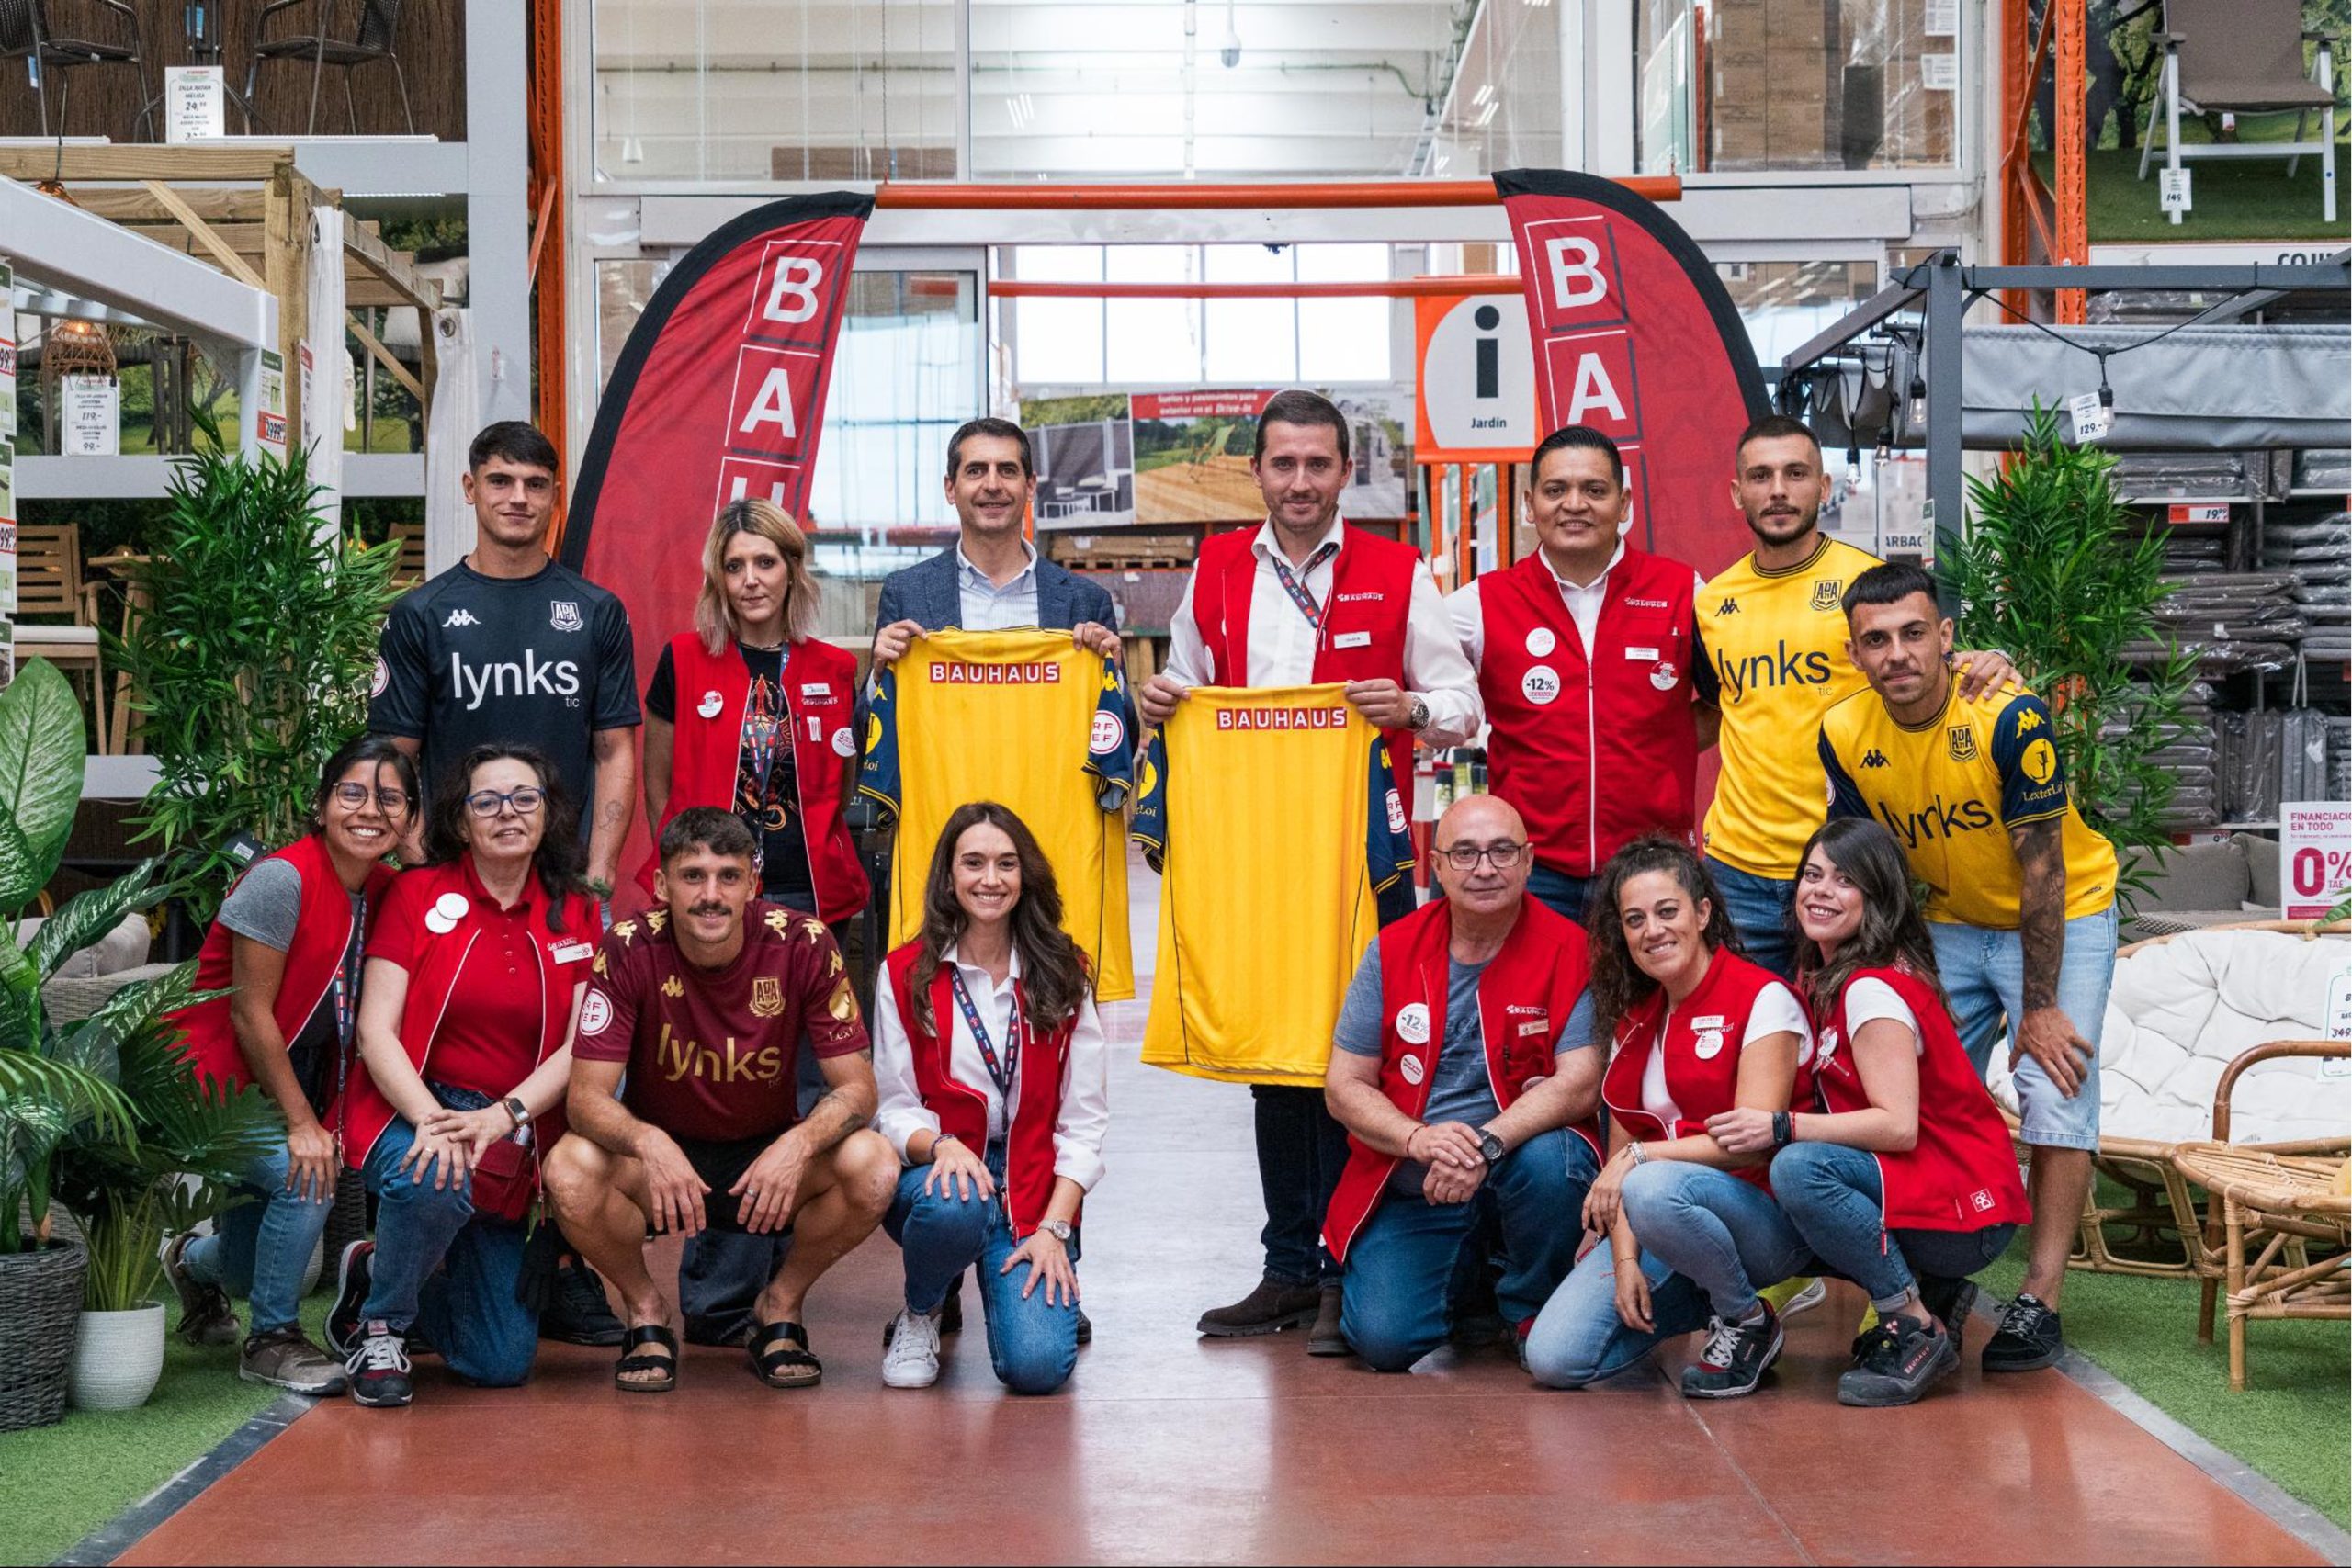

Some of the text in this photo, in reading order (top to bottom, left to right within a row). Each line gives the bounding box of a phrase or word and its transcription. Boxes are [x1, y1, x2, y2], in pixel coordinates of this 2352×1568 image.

[451, 649, 580, 710] lynks
[931, 663, 1059, 682] BAUHAUS
[1717, 640, 1831, 705] lynks
[1526, 678, 1555, 692] -12%
[565, 695, 580, 708] tic
[1218, 708, 1346, 728] BAUHAUS
[2290, 822, 2334, 831] EN TODO
[657, 1023, 782, 1082] lynks
